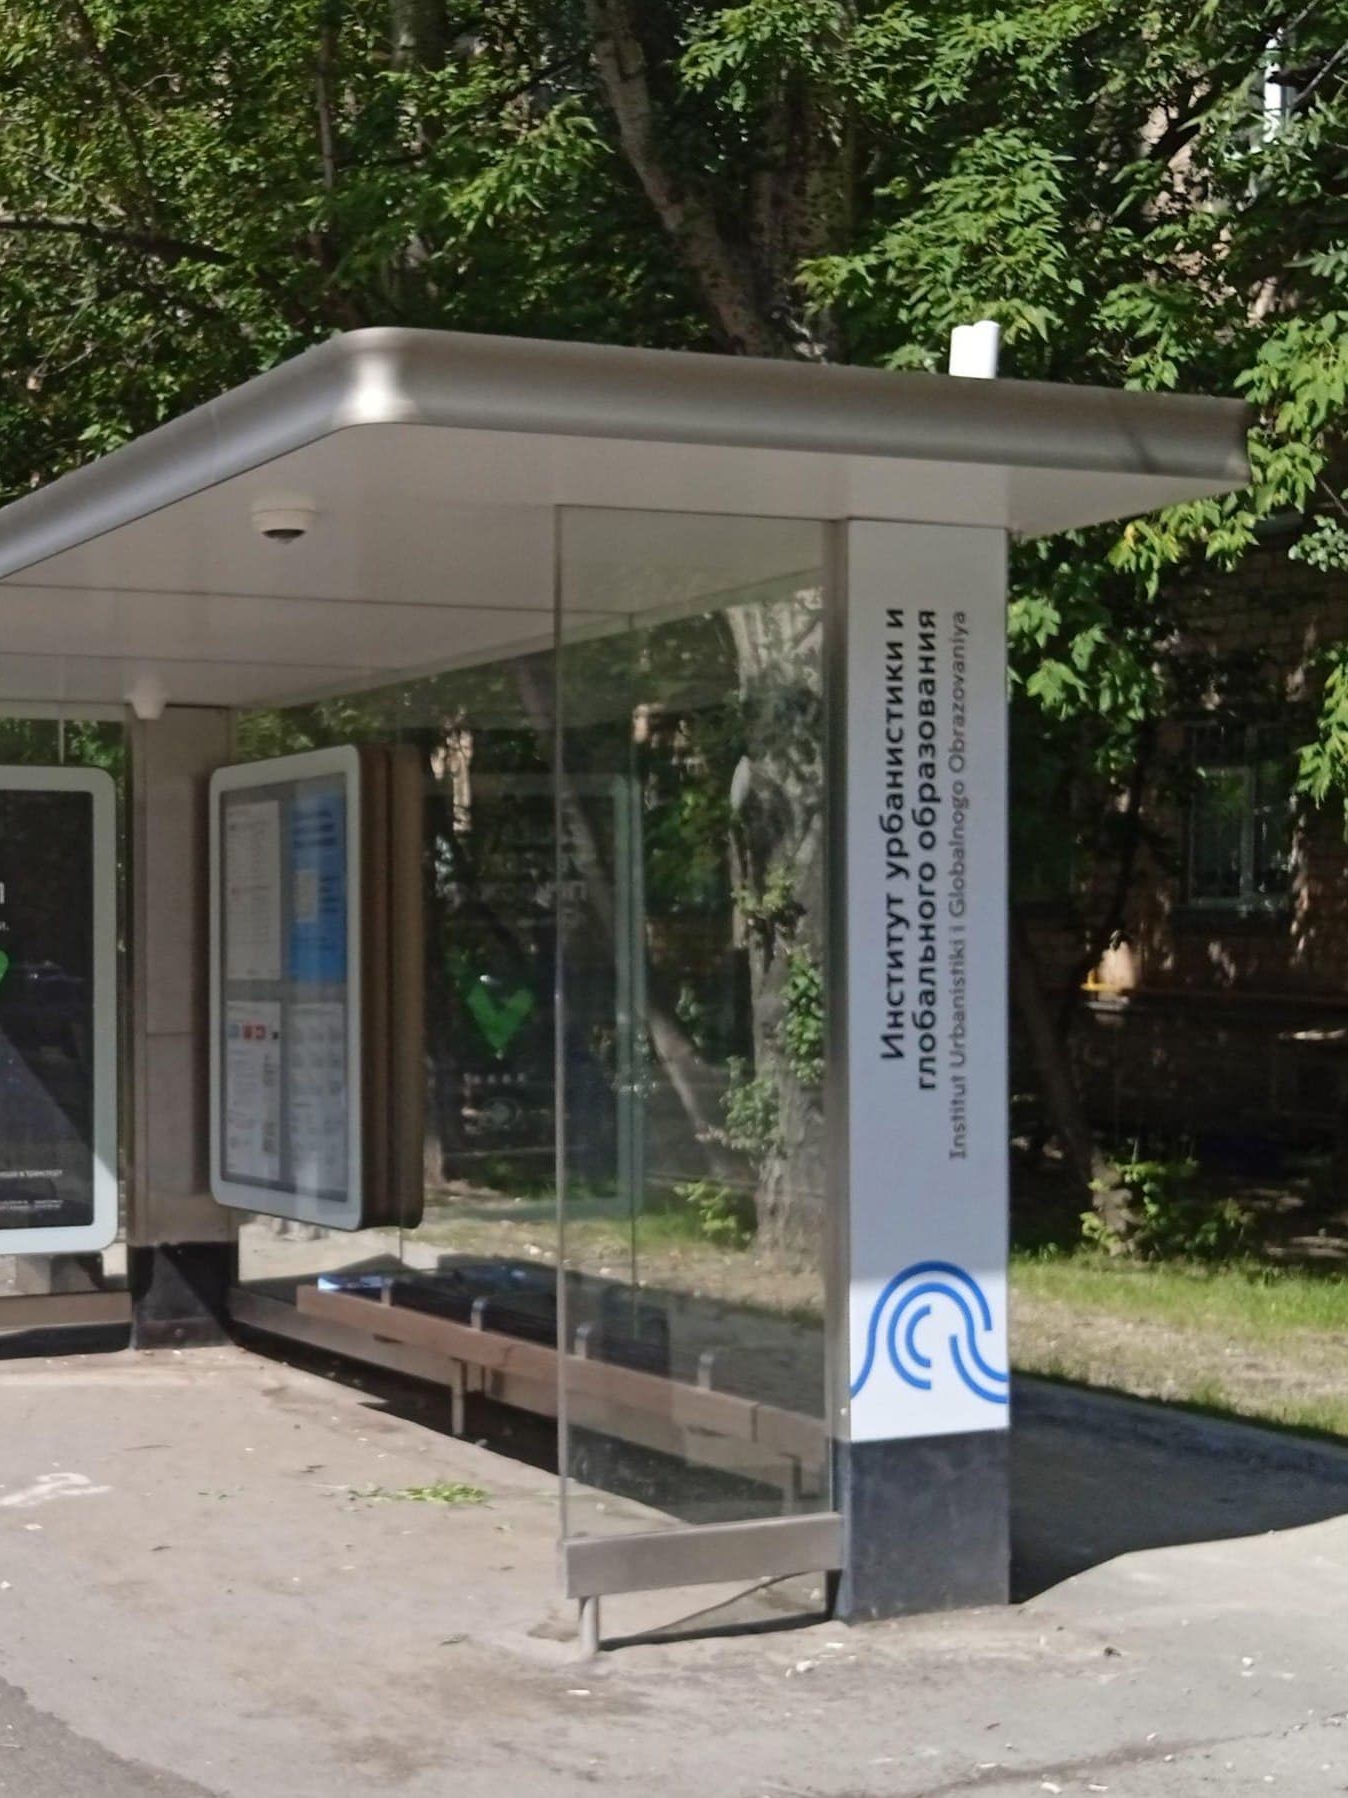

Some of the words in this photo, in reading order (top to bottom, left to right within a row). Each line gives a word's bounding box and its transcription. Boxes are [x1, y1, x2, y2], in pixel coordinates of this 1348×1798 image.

[886, 608, 904, 628] и
[949, 611, 969, 773] Obrazovaniya
[880, 642, 909, 879] урбанистики
[912, 610, 941, 850] образования
[949, 780, 969, 918] Globalnogo
[881, 893, 910, 1059] Институт
[912, 861, 936, 1090] глобального
[949, 940, 966, 1068] Urbanistiki
[949, 1075, 966, 1159] Institut
